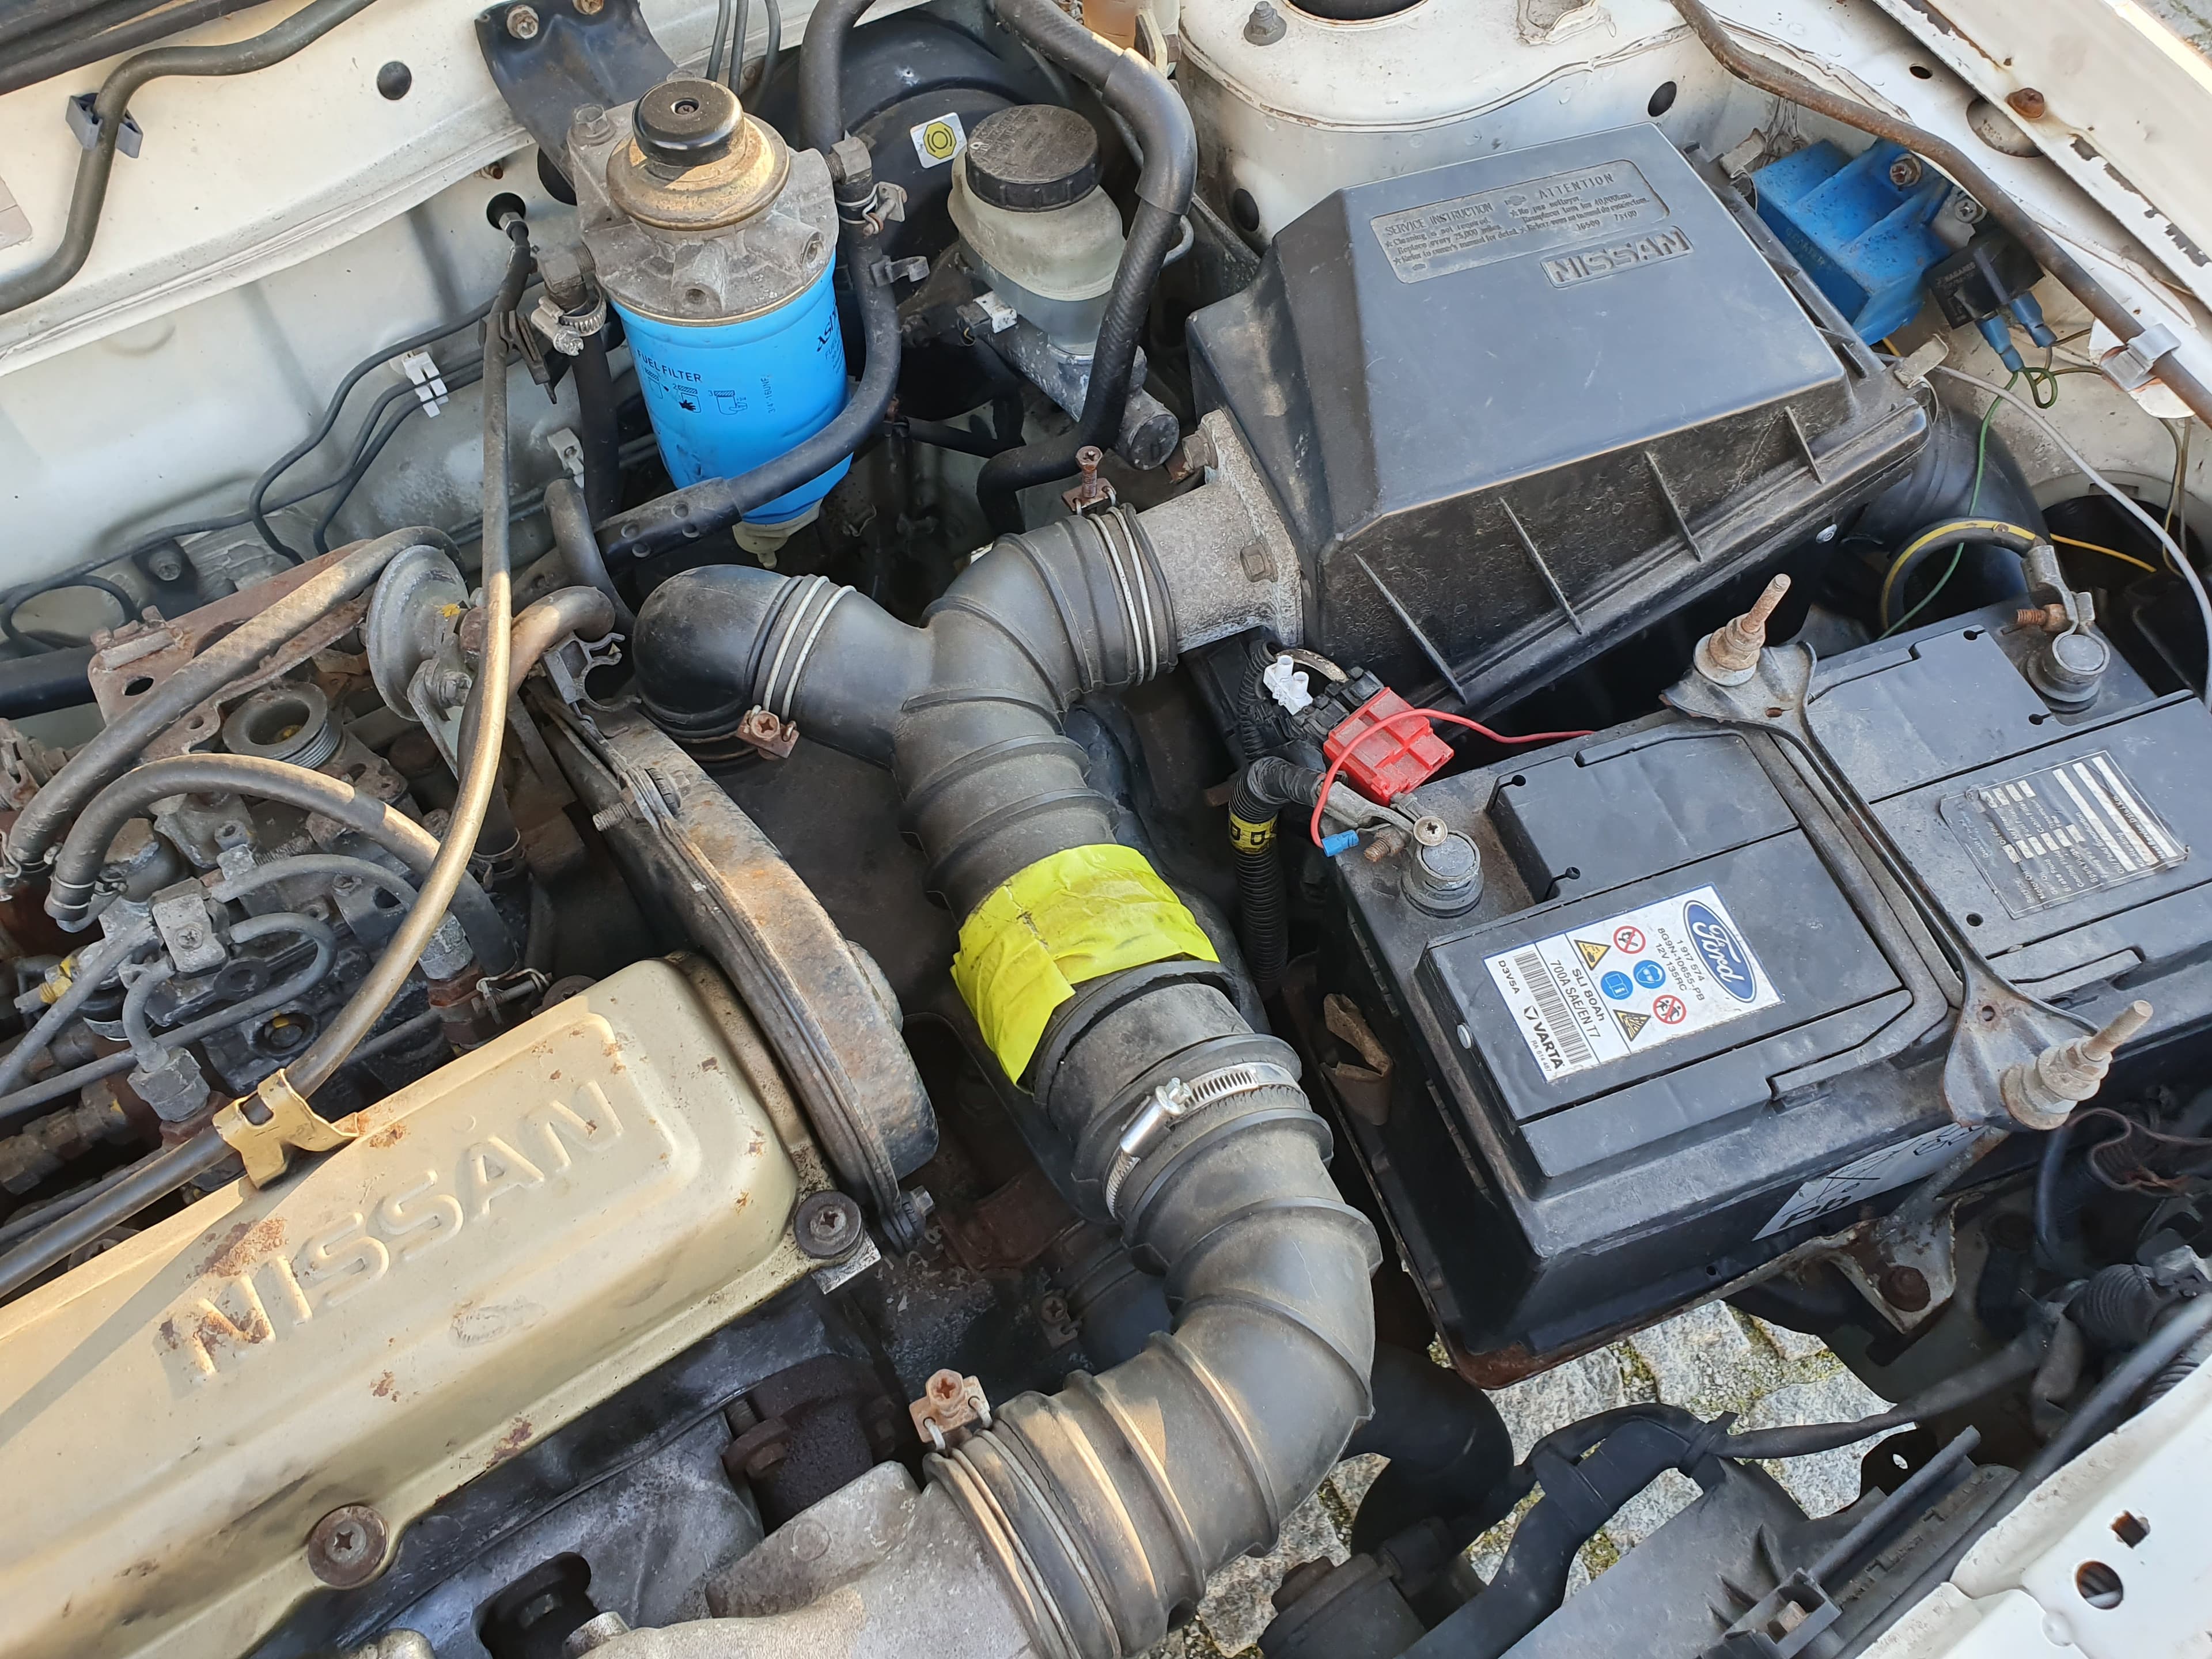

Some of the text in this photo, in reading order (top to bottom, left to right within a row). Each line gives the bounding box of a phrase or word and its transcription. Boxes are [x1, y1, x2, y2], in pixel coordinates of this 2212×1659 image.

[1539, 173, 1613, 199] ATTENTION
[1385, 202, 1493, 235] SERVICE INSTRUCTION
[1553, 232, 1690, 282] NISSAN
[637, 349, 702, 383] FUEL FILTER
[2028, 815, 2044, 834] Cabin
[2044, 858, 2058, 873] Fluid
[2022, 870, 2046, 900] Motor Oil
[1654, 942, 1687, 993] 12V 135RC
[1656, 926, 1705, 1002] 8G9N-10655-PB
[1680, 945, 1694, 964] 917
[1690, 963, 1705, 982] 574
[1693, 921, 1745, 983] Ford
[1497, 959, 1521, 995] D3V5A
[1571, 967, 1606, 1022] SLI 80Ah
[1550, 959, 1600, 1041] 700A SAE/EN T7
[1531, 1039, 1552, 1073] RA 614 487
[1532, 1021, 1564, 1070] VARTA
[180, 1080, 625, 1378] NISSAN
[1779, 1196, 1851, 1229] Pb
